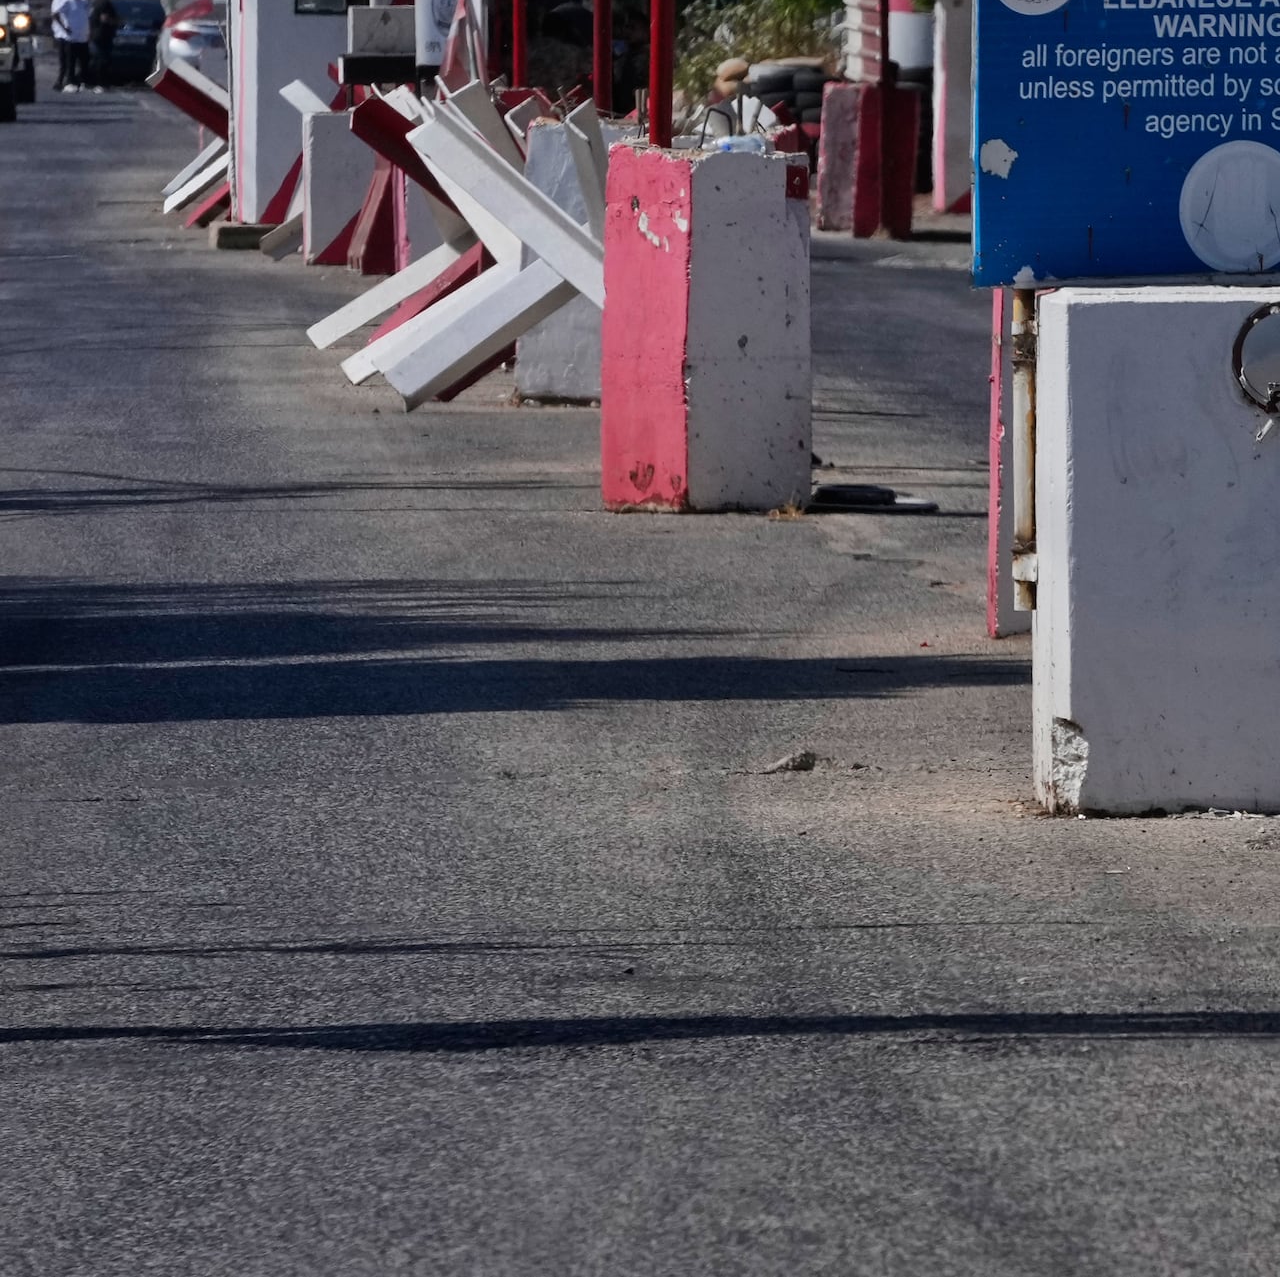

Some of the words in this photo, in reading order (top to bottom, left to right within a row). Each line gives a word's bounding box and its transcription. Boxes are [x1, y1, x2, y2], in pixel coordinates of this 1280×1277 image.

[1022, 43, 1047, 68] all
[1054, 43, 1174, 72] foreigners
[1182, 47, 1221, 65] are
[1229, 42, 1267, 64] not
[1019, 75, 1095, 100] unless
[1102, 73, 1215, 104] permitted
[1224, 73, 1252, 102] by
[1145, 113, 1234, 139] agency
[1242, 108, 1262, 131] in
